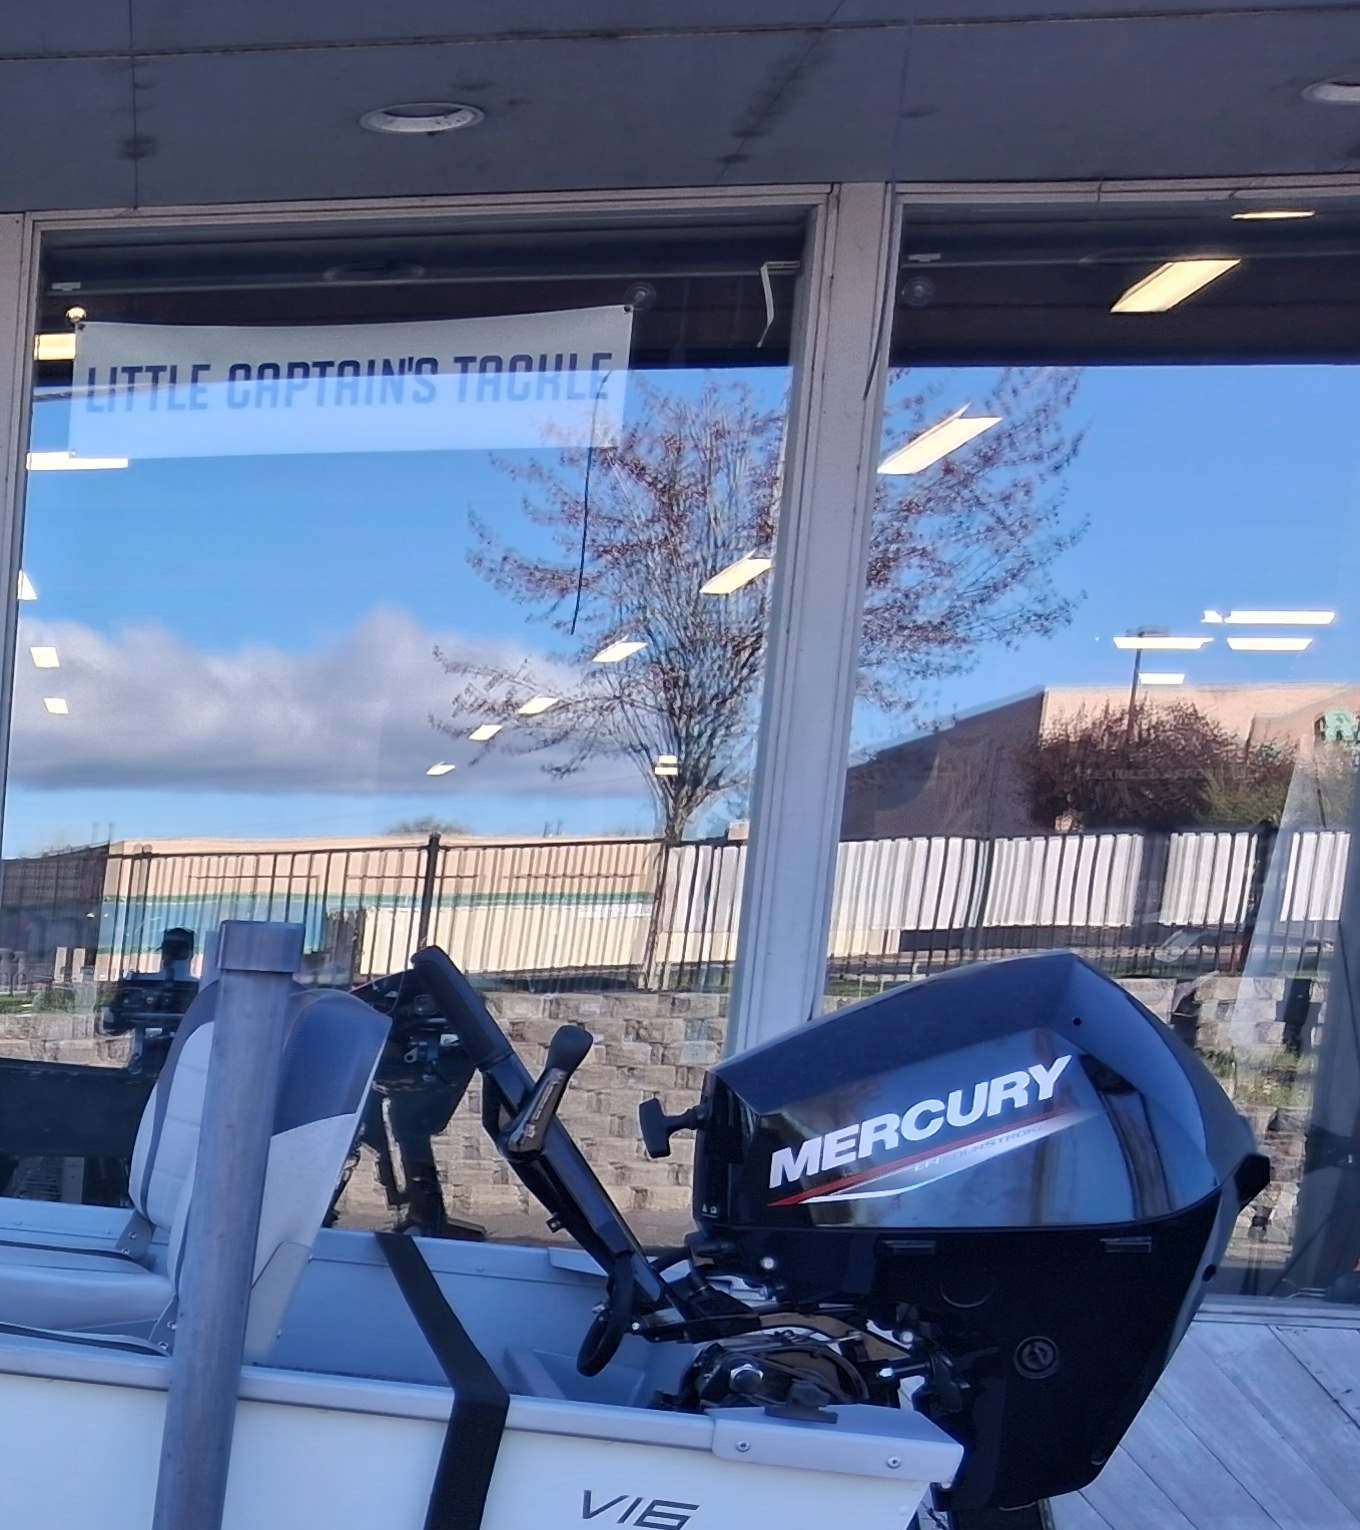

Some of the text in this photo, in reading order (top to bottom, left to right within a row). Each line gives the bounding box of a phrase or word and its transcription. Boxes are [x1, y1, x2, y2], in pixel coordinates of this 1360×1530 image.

[86, 352, 614, 413] LITTLE CAPTAIN'S TACKLE
[769, 1055, 1071, 1188] MERCURY
